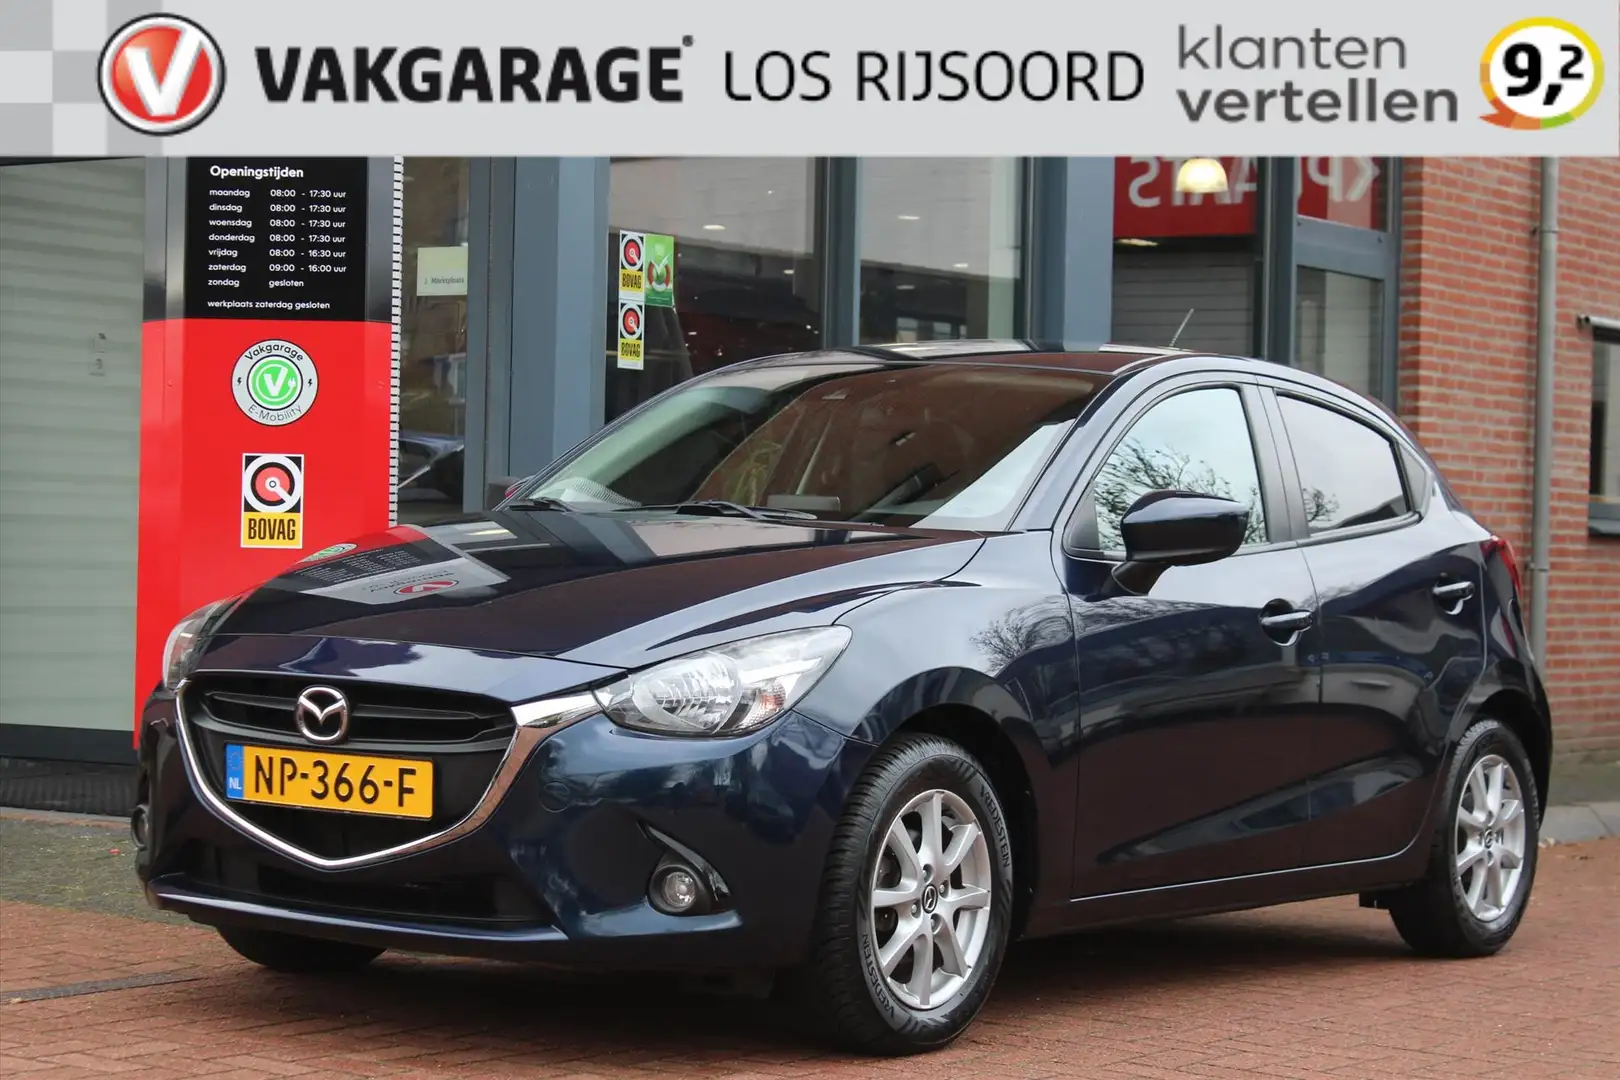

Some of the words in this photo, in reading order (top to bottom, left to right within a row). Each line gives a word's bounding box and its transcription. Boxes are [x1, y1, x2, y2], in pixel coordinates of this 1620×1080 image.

[209, 164, 304, 180] Openingstijden
[209, 188, 251, 198] maandag
[269, 188, 296, 197] 08:00
[308, 189, 332, 198] 17:30
[208, 203, 243, 213] dinsdag
[269, 203, 296, 212] 08:00
[308, 204, 332, 213] 17:30
[208, 218, 252, 228] woensdag
[269, 218, 296, 227] 08:00
[308, 219, 332, 228] 17:30
[208, 233, 256, 243] donderdag
[269, 233, 296, 242] 08:00
[308, 234, 332, 243] 17:30
[208, 248, 238, 258] vrijdag
[269, 248, 296, 257] 08:00
[308, 249, 332, 258] 16:30
[208, 263, 247, 273] zaterdag
[269, 263, 296, 272] 09:00
[308, 264, 332, 273] 16:00
[207, 278, 240, 288] zondag
[268, 278, 305, 288] gesloten
[207, 299, 254, 310] werkplaats
[254, 300, 293, 310] zaterdag
[294, 300, 331, 310] gesloten
[244, 343, 304, 362] Vakgarage
[247, 403, 303, 422] E-Mobility
[247, 517, 297, 541] BOVAG
[228, 776, 243, 791] NL
[254, 754, 418, 808] NP-366-F
